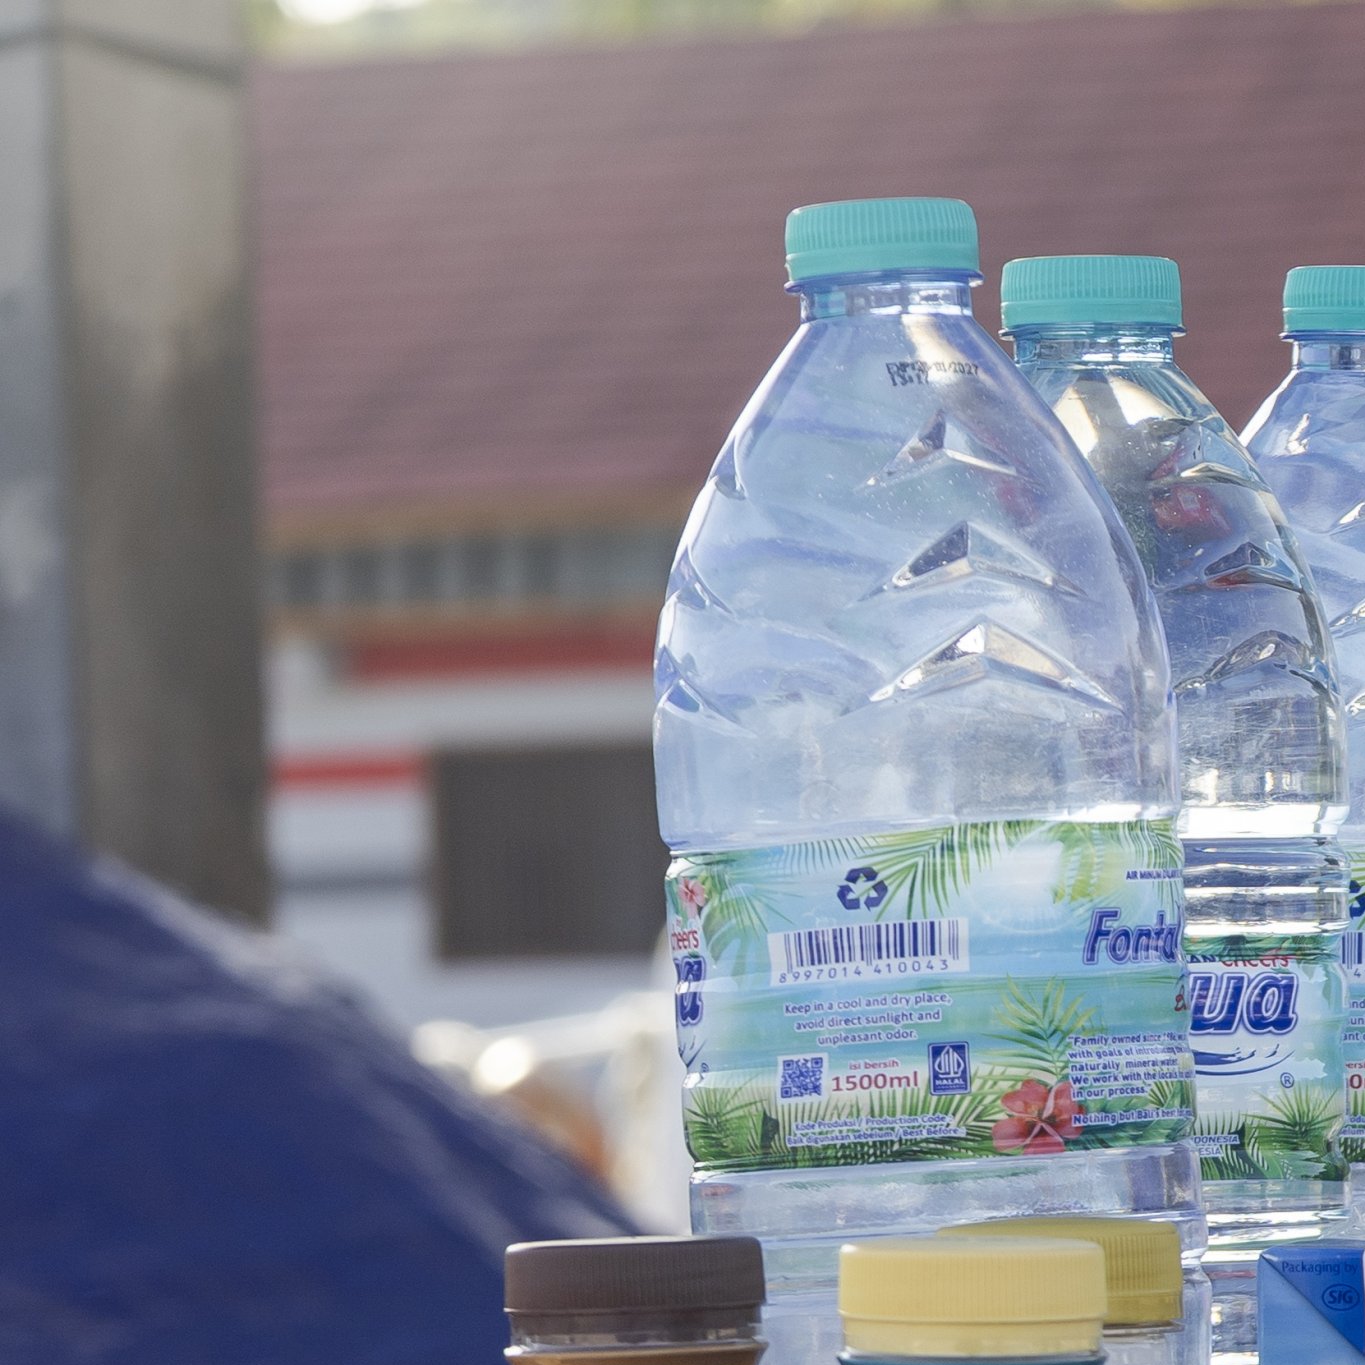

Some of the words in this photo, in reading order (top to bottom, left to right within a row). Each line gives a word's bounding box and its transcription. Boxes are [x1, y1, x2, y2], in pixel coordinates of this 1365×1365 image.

[784, 1004, 811, 1015] Keep
[813, 1002, 824, 1011] in
[827, 1003, 834, 1011] a
[837, 997, 862, 1010] cool
[865, 996, 888, 1008] and
[892, 995, 911, 1009] dry
[914, 993, 952, 1005] place,
[795, 1019, 825, 1031] avoid
[828, 1016, 862, 1028] direct
[865, 1011, 914, 1026] sunlight
[917, 1010, 941, 1021] and
[817, 1030, 883, 1046] unpleasant
[886, 1030, 917, 1040] odor.
[1112, 1034, 1141, 1044] owned
[1068, 1050, 1092, 1060] with
[1095, 1048, 1122, 1059] goals
[1125, 1047, 1134, 1056] of
[848, 1062, 861, 1070] isi
[864, 1060, 899, 1069] bersih
[1070, 1060, 1120, 1072] naturally
[1125, 1059, 1159, 1068] mineral
[832, 1071, 919, 1092] 1500ml
[1071, 1076, 1089, 1085] We
[1093, 1073, 1119, 1084] work
[1122, 1071, 1141, 1081] with
[1144, 1071, 1157, 1080] the
[1072, 1088, 1084, 1098] in
[1087, 1088, 1105, 1098] our
[865, 1115, 920, 1126] Production
[921, 1115, 946, 1123] Code
[1073, 1112, 1117, 1125] Nothing
[1119, 1110, 1135, 1120] but
[902, 1127, 923, 1137] Best
[926, 1126, 959, 1135] Before
[1282, 1261, 1341, 1276] Packaging
[1344, 1262, 1359, 1275] by
[1328, 1290, 1354, 1305] SIG
